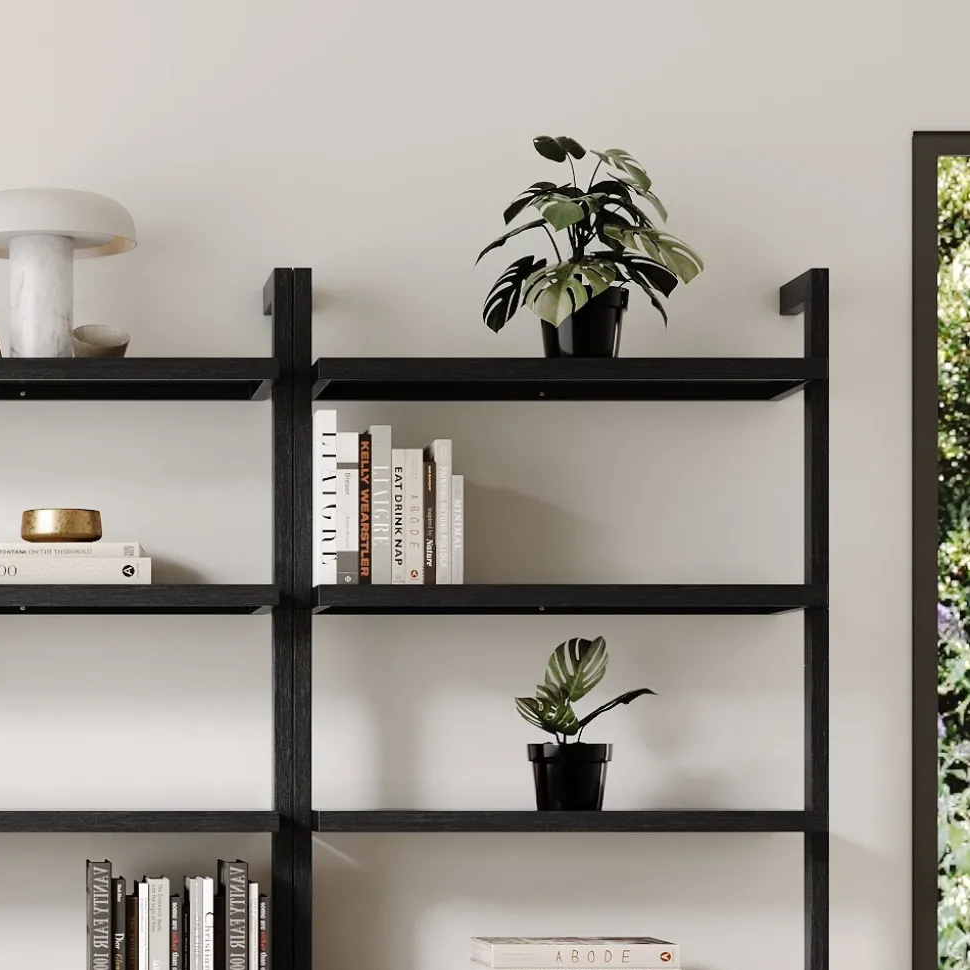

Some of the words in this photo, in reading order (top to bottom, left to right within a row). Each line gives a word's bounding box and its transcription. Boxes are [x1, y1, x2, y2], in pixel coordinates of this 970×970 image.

[360, 440, 370, 484] KELLY
[394, 466, 403, 491] EAT
[439, 466, 448, 502] PAINTING
[372, 465, 390, 546] LIAIGRE
[394, 494, 403, 535] DRINK
[426, 507, 434, 529] Inspired
[439, 502, 448, 532] BEYOND
[360, 489, 370, 577] WEARSTLER
[454, 498, 462, 550] MINIMAL
[394, 538, 403, 566] NAP
[426, 539, 434, 567] Nature
[439, 534, 448, 568] POLLOCK
[114, 932, 125, 950] Dior
[172, 952, 180, 966] than
[260, 952, 268, 966] than
[555, 949, 631, 963] ABODE
